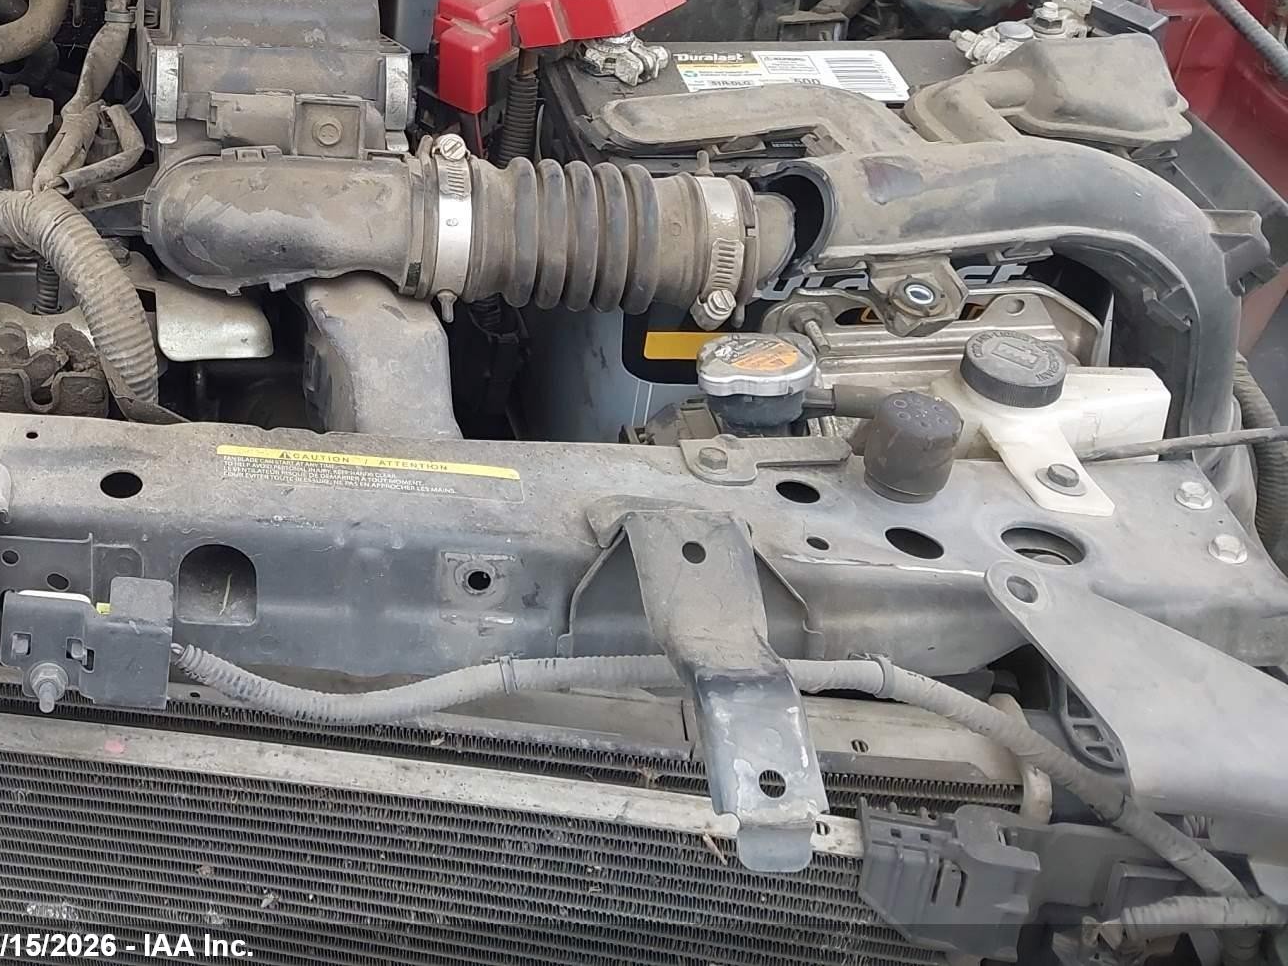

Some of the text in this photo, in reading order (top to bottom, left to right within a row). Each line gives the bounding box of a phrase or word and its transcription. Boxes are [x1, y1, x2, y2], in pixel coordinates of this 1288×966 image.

[673, 52, 745, 64] Duralast
[293, 453, 350, 463] CAUTION
[378, 460, 448, 470] ATTENTION
